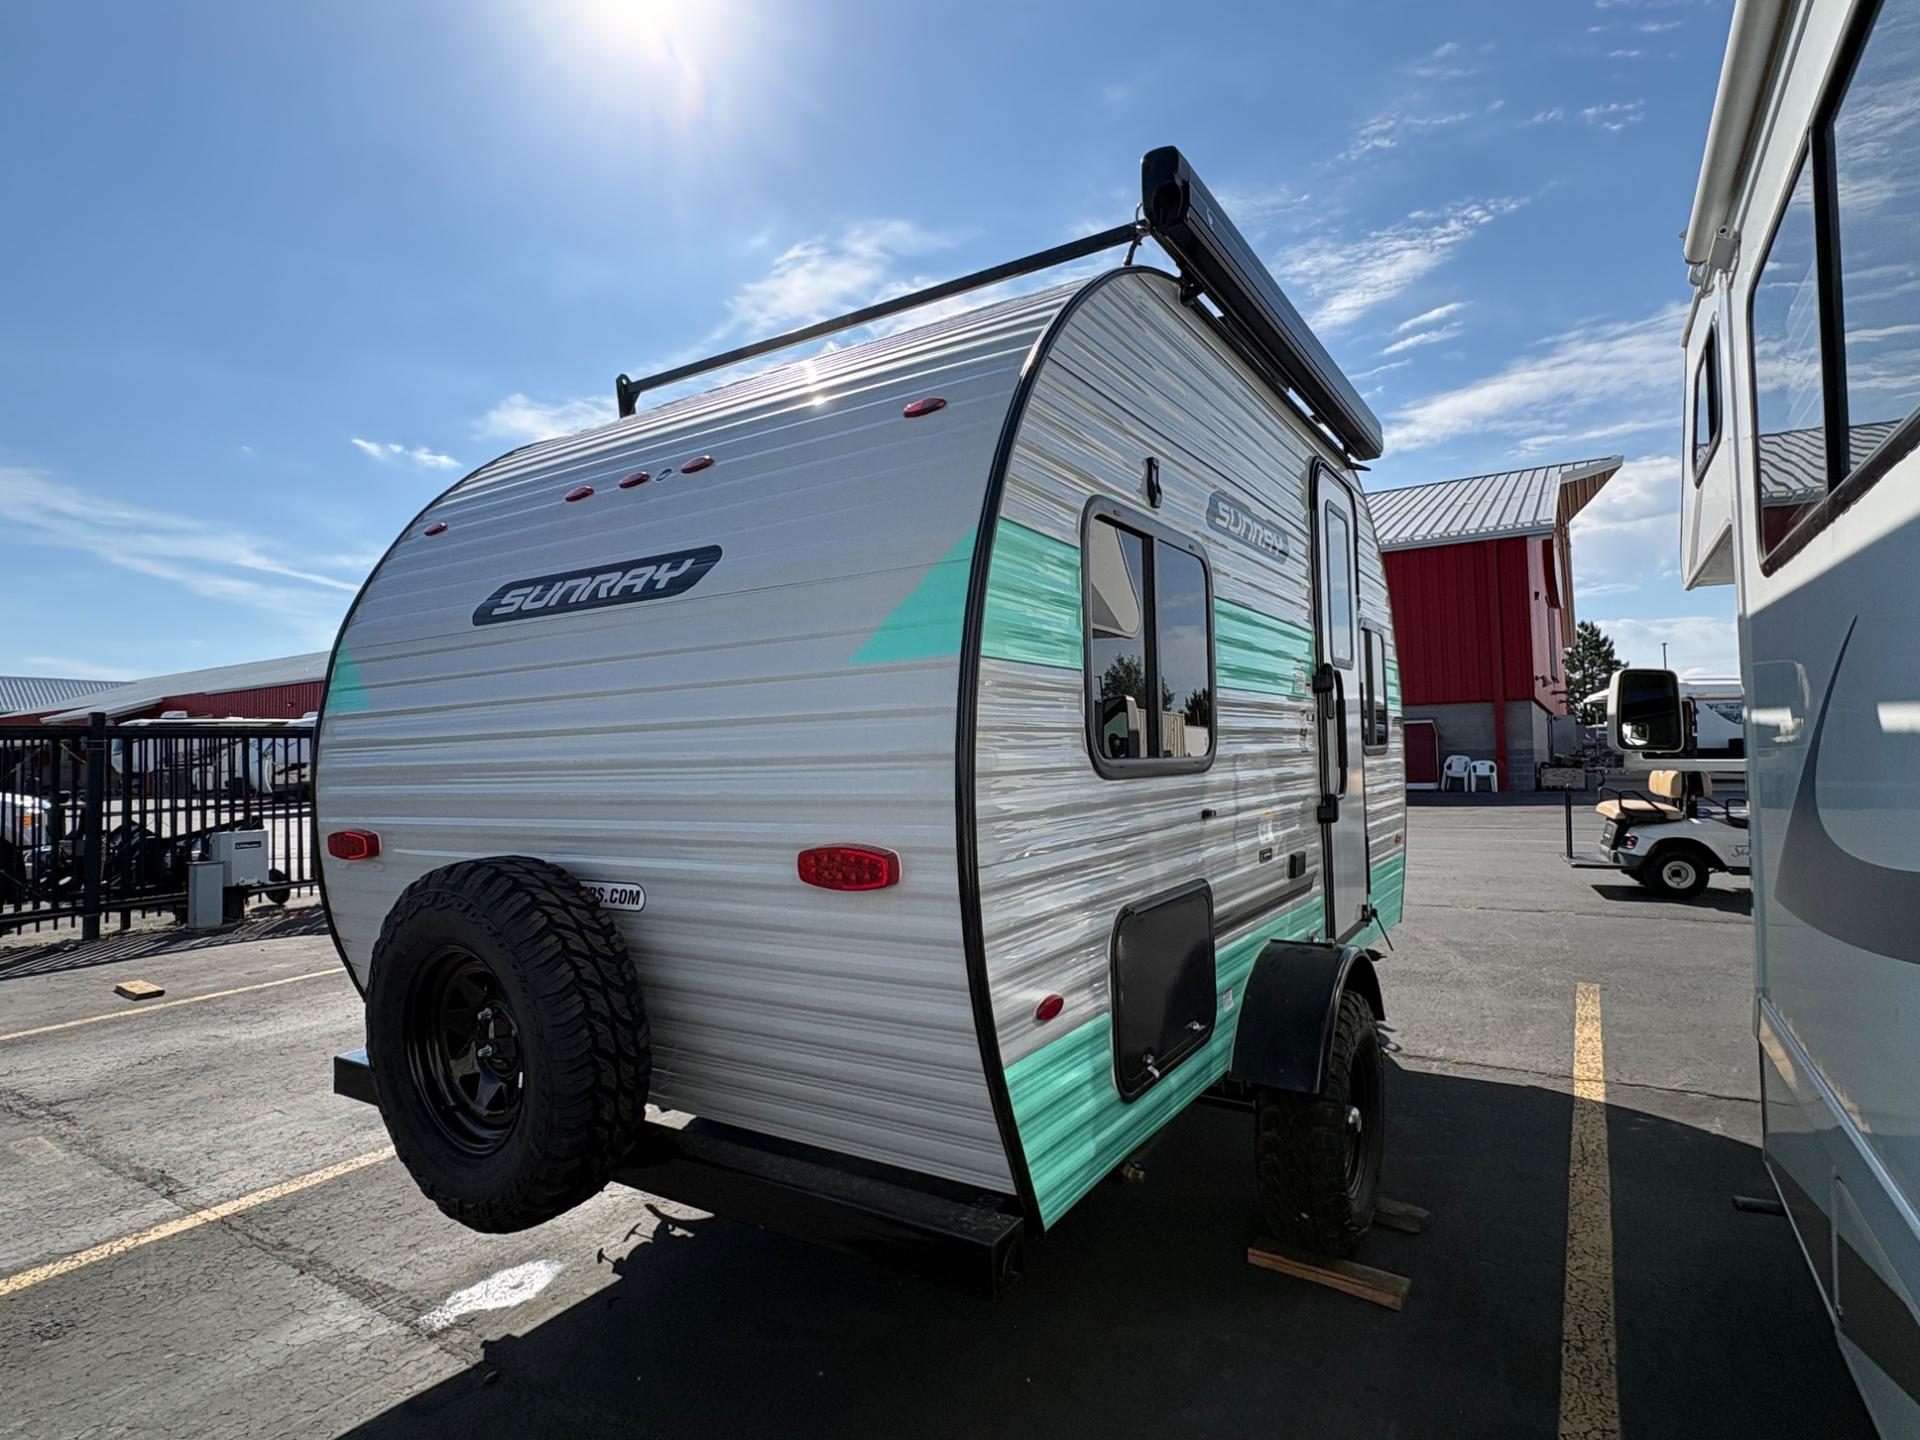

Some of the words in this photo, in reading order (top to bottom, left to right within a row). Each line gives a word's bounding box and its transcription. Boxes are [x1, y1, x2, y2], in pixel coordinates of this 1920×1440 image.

[1215, 501, 1284, 555] SUNRAY
[491, 558, 696, 616] SUNRAY
[581, 886, 641, 906] S.COM
